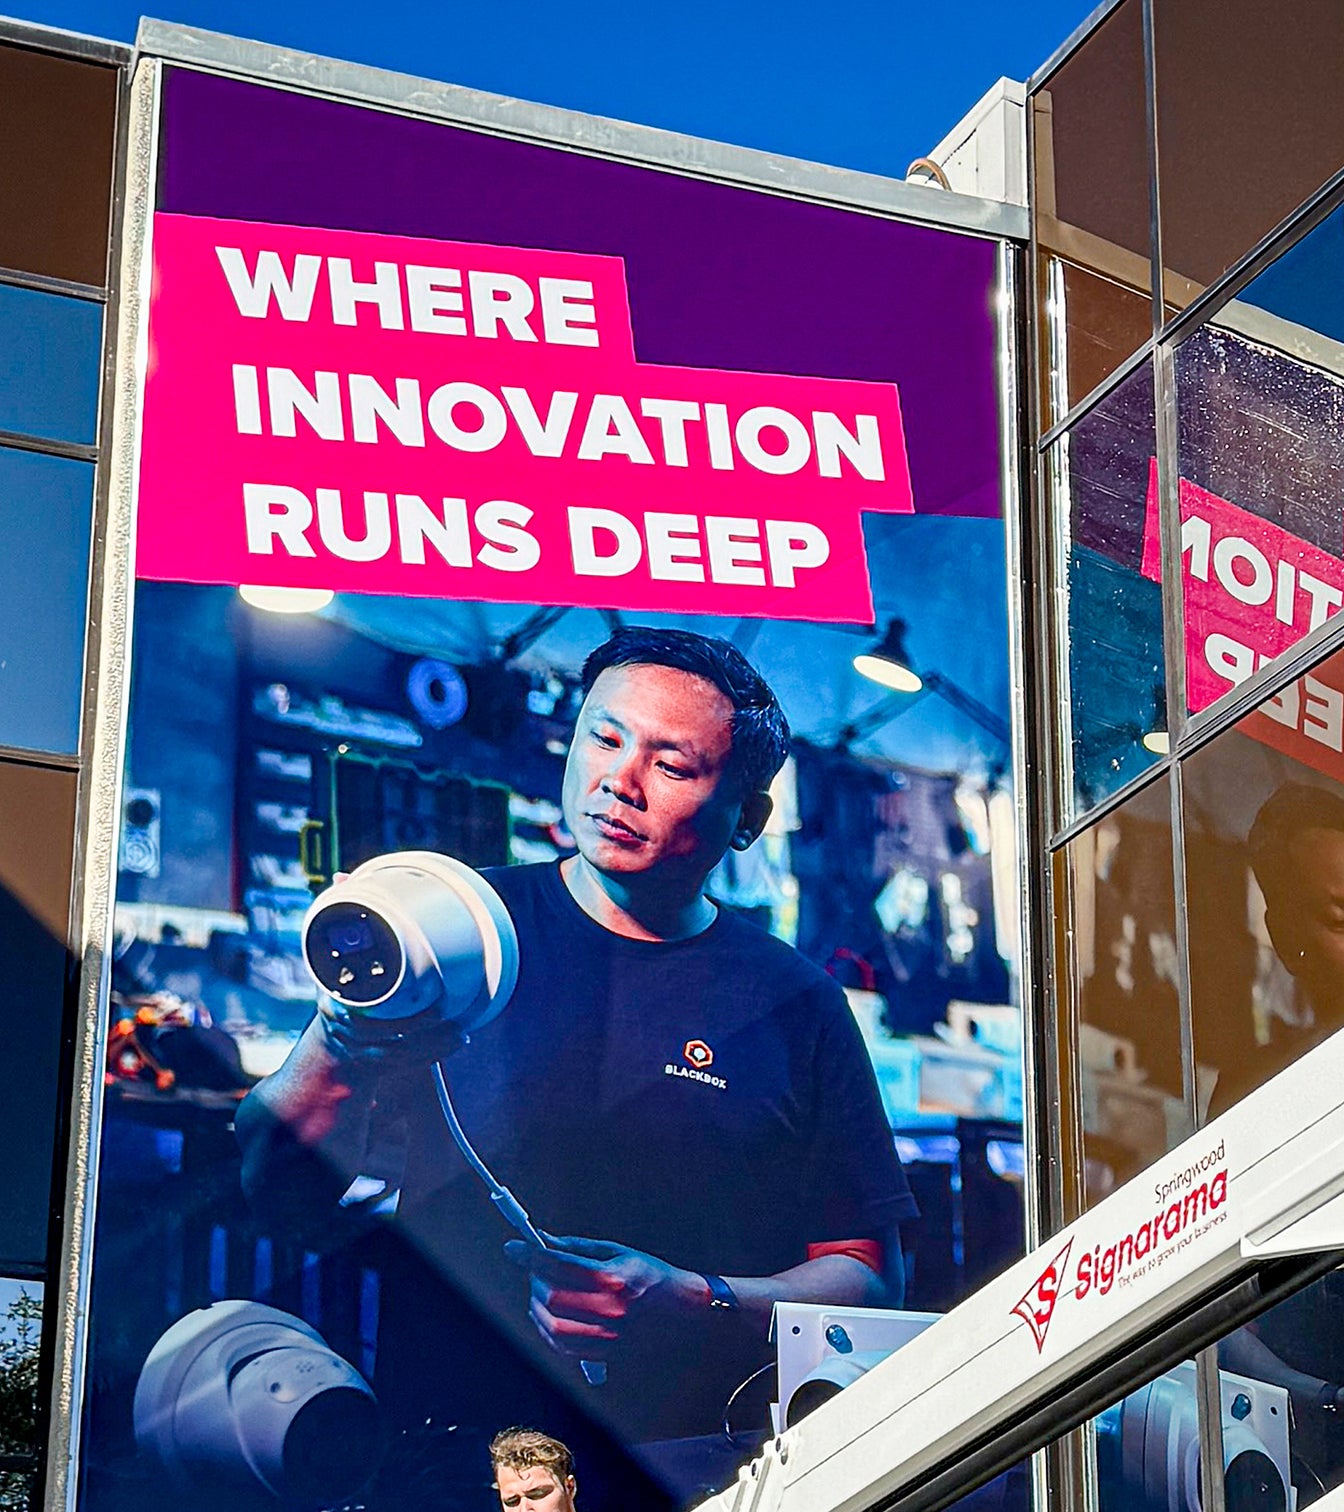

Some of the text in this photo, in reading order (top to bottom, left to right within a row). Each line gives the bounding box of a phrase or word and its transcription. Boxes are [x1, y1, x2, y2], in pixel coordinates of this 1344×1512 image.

[215, 245, 600, 348] WHERE
[232, 364, 886, 481] INNOVATION
[242, 483, 830, 589] RUNS DEEP
[664, 1064, 727, 1090] BLACKBOX
[1154, 1138, 1226, 1205] Springwood
[1075, 1168, 1228, 1301] Signarama
